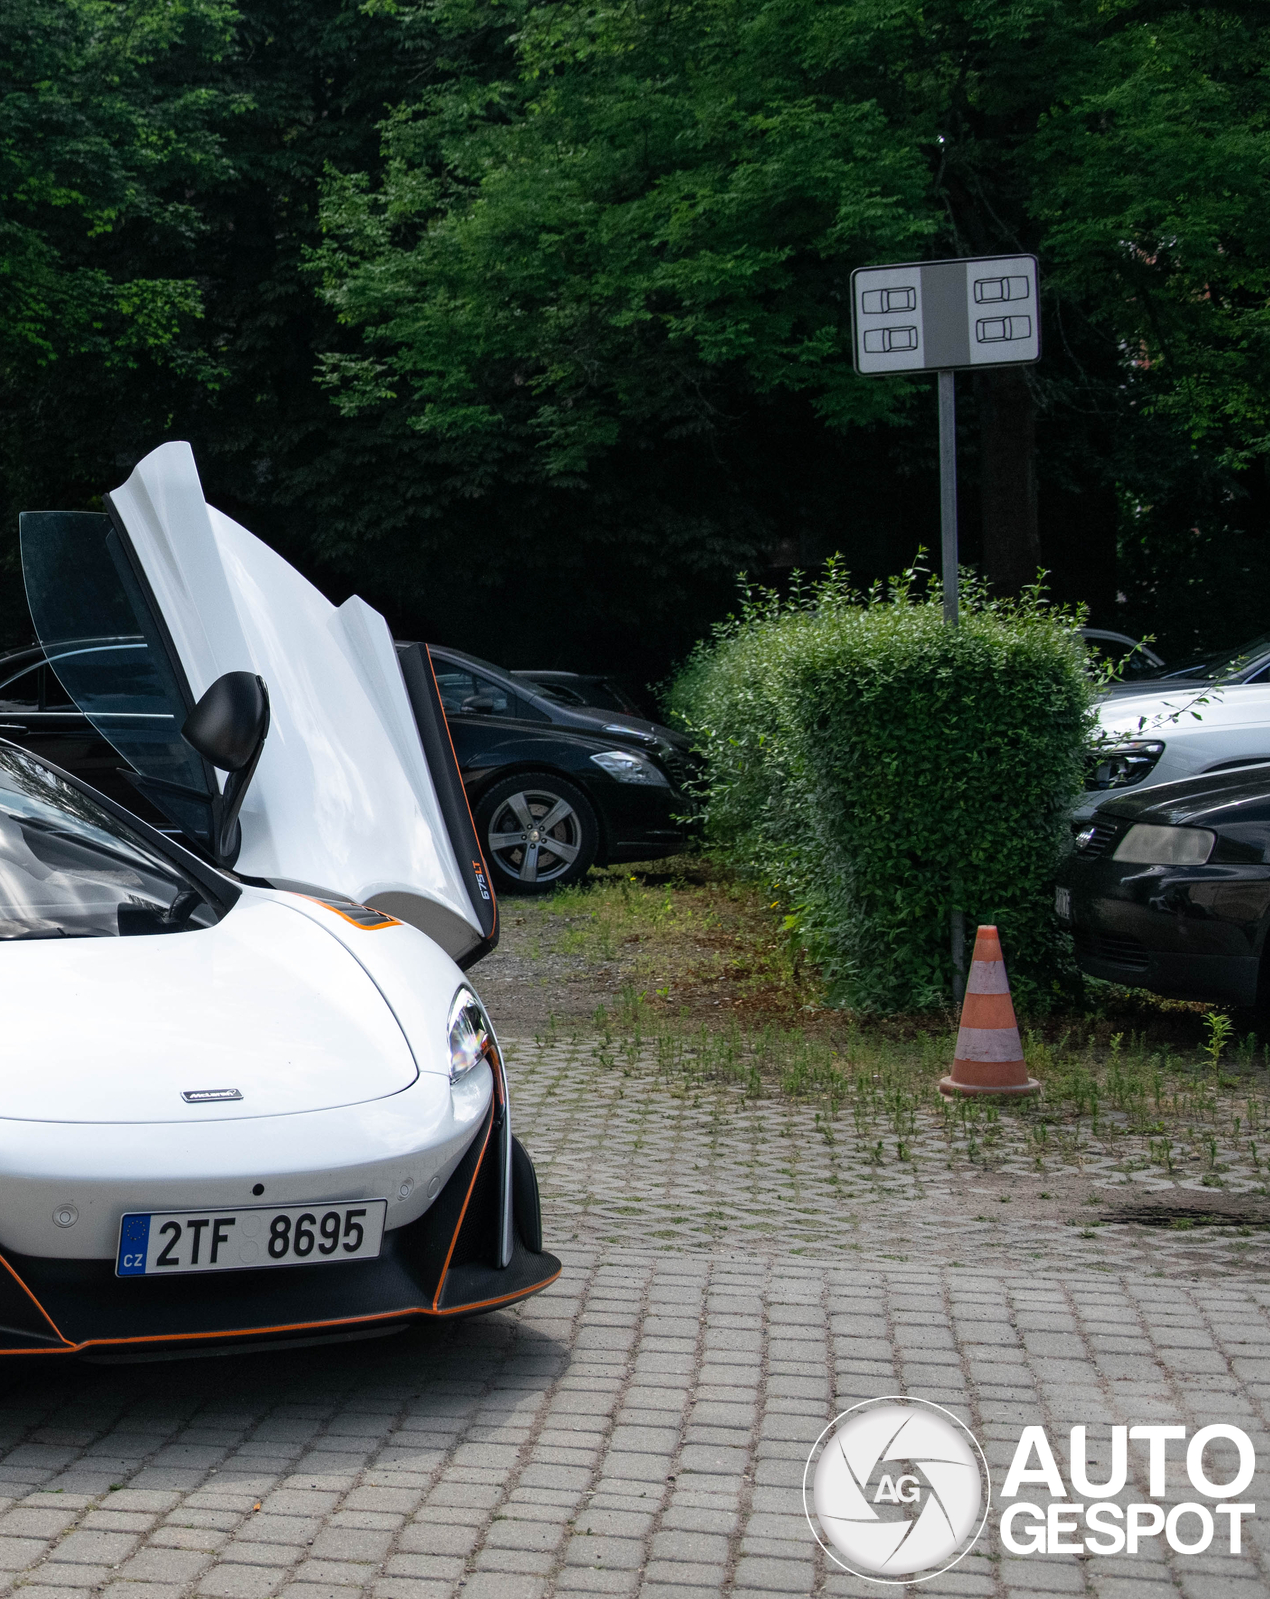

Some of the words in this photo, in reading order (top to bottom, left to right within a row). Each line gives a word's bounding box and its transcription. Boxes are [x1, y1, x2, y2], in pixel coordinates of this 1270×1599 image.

[472, 860, 490, 900] 675LT
[156, 1217, 236, 1267] 2TF
[267, 1208, 367, 1259] 8695
[123, 1253, 143, 1268] CZ
